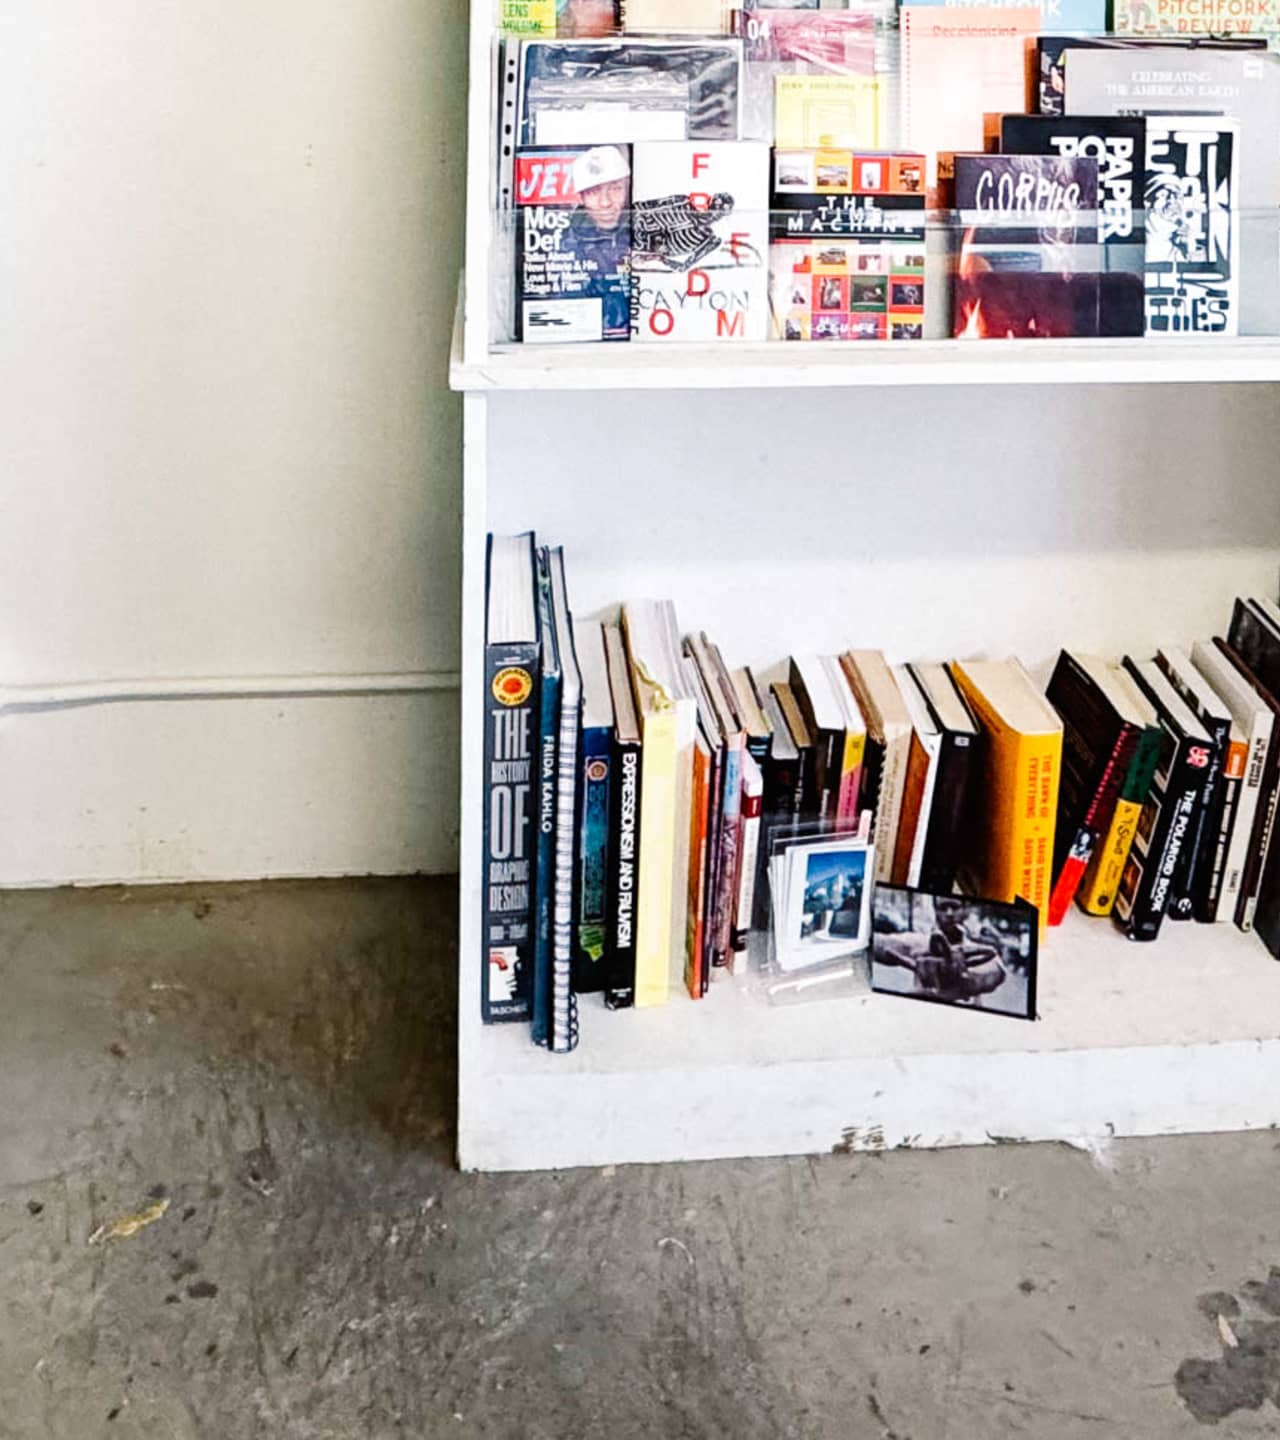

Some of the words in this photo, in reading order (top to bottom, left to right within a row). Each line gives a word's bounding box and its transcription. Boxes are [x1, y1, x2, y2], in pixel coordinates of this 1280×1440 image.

[503, 5, 529, 17] LENS
[1177, 18, 1253, 33] REVIEW
[748, 19, 770, 41] 04
[1106, 83, 1128, 95] THE
[1131, 83, 1195, 96] AMERICAN
[826, 196, 876, 209] THE
[976, 170, 1081, 222] CORPUS
[1105, 137, 1134, 239] PAPER
[524, 207, 570, 230] Mos
[787, 218, 915, 233] MACHINE
[524, 228, 563, 252] Def
[524, 262, 545, 273] New
[545, 262, 573, 272] Movie
[583, 261, 599, 271] His
[547, 250, 576, 261] About
[524, 273, 547, 283] Love
[524, 283, 552, 295] Stage
[561, 282, 582, 293] Film
[491, 710, 532, 761] THE
[543, 735, 555, 776] FRIDA
[1042, 754, 1053, 774] THE
[1025, 757, 1040, 819] EVERYTHING
[1041, 776, 1052, 805] DAWN
[1179, 787, 1197, 814] THE
[541, 778, 554, 834] KAHLO
[619, 751, 637, 859] EXPRESSIONISM
[490, 785, 530, 859] OF
[1023, 837, 1035, 866] DAVID
[1036, 836, 1048, 865] DAVID
[1160, 813, 1188, 876] POLAROID
[618, 861, 634, 890] AND
[490, 882, 529, 911] DESIGN
[1149, 875, 1169, 912] BOOK
[615, 891, 634, 948] FAUVISM
